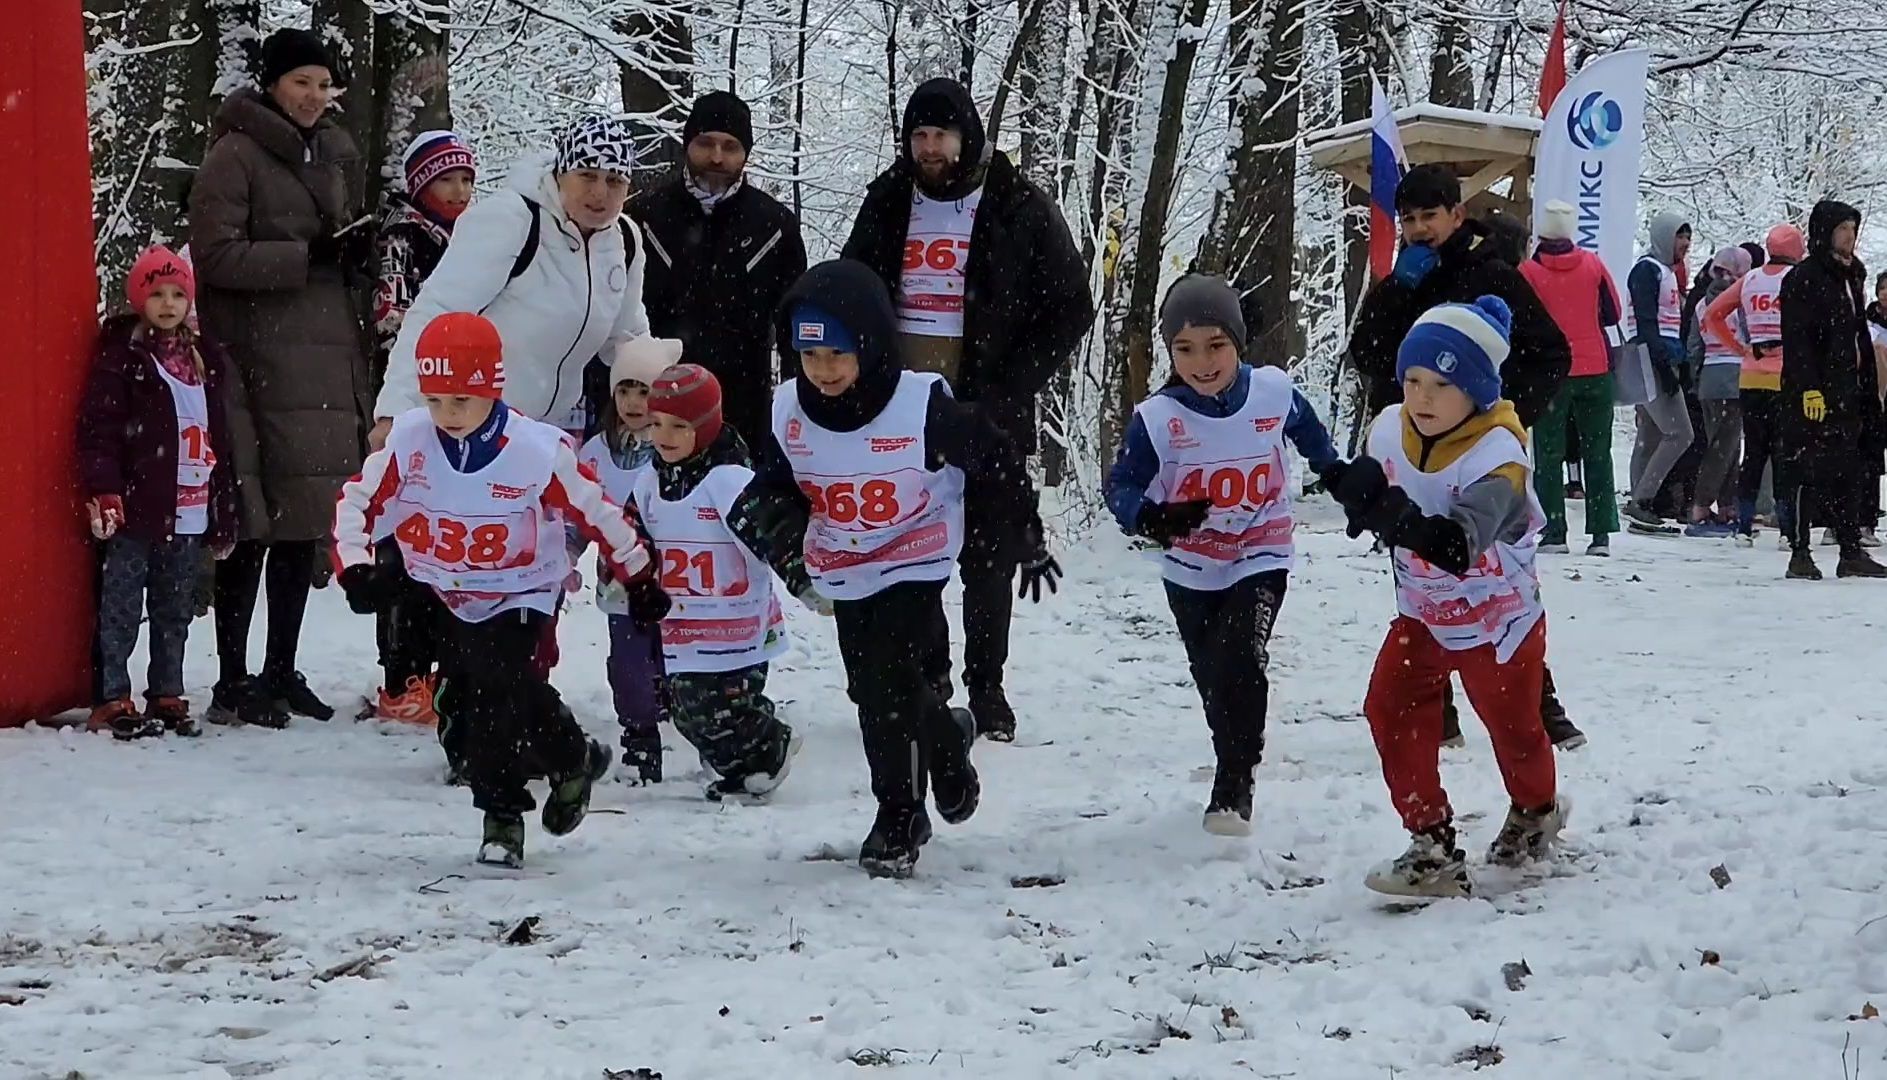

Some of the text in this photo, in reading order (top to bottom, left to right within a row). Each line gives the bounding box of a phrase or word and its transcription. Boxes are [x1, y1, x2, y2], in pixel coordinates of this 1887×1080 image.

[413, 153, 467, 189] ЛЫЖНЯ
[1577, 161, 1602, 254] МИКС
[1176, 463, 1270, 508] 400
[396, 512, 509, 563] 438
